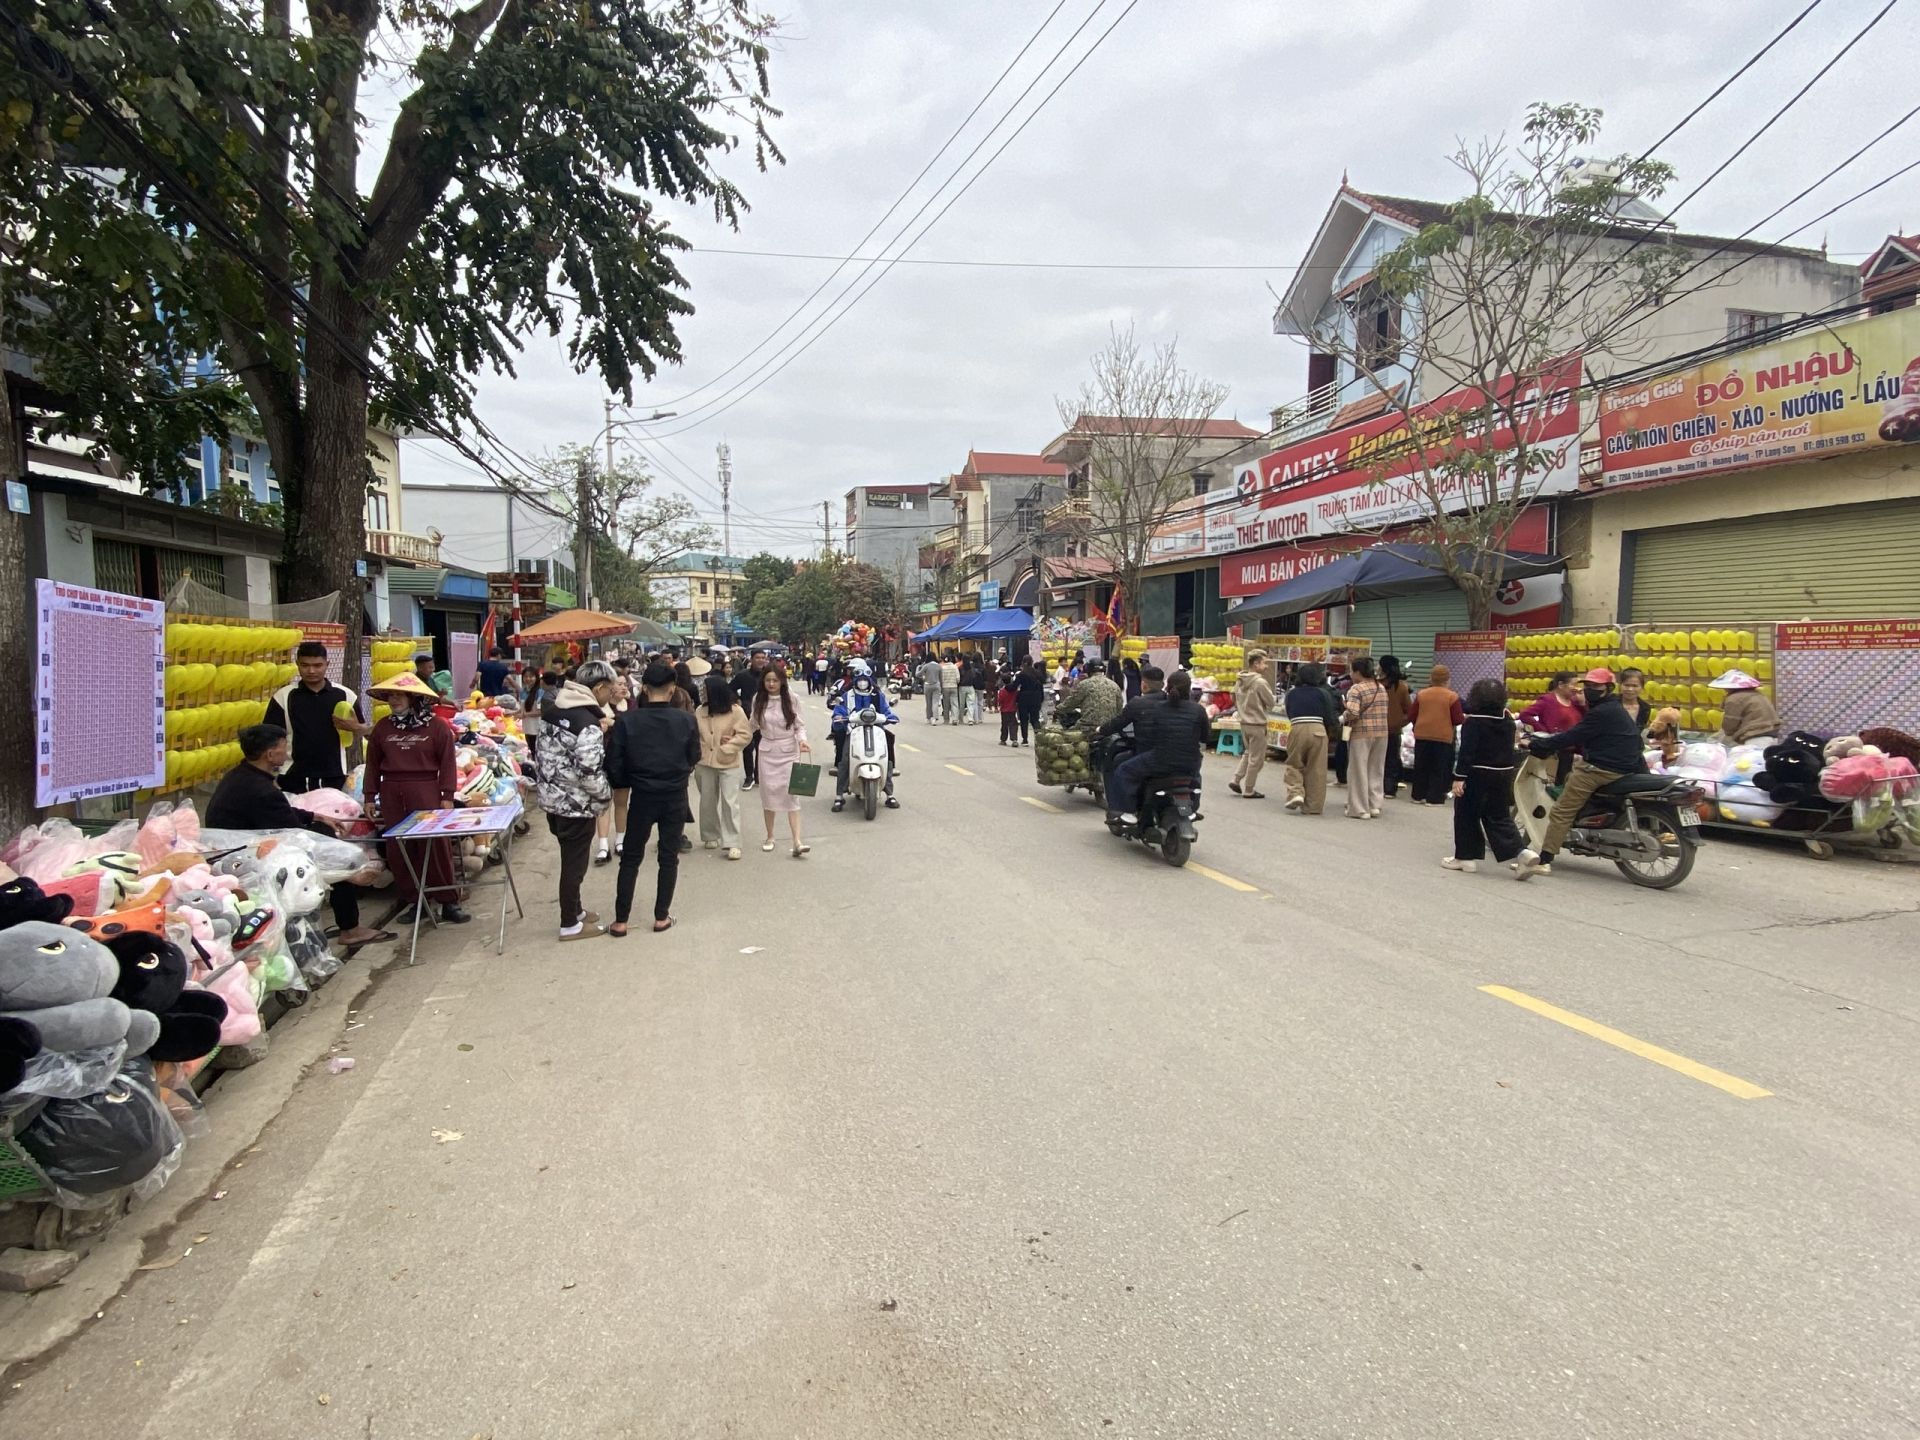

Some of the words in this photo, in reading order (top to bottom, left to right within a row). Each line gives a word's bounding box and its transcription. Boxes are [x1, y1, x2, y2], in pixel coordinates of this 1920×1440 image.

[1653, 378, 1684, 399] Giới
[1696, 368, 1744, 407] ĐỒ
[1756, 347, 1854, 392] NHẬU
[1607, 431, 1632, 454] CÁC
[1636, 424, 1668, 448] MÓN
[1732, 404, 1764, 430] XÀO
[1781, 388, 1844, 420] NƯỚNG
[1863, 370, 1900, 404] LẨU
[1691, 439, 1711, 454] Có
[1713, 435, 1745, 451] ship
[1750, 427, 1776, 445] tận
[1782, 423, 1809, 438] nơi
[1269, 448, 1340, 492] CALTEX
[1317, 498, 1347, 519] TRUNG
[1350, 491, 1372, 512] TÂM
[1268, 512, 1308, 541] MOTOR
[1241, 564, 1267, 585] MUA
[1270, 556, 1294, 582] BÁN
[1786, 626, 1807, 634] VUI
[1811, 624, 1849, 634] XUÂN
